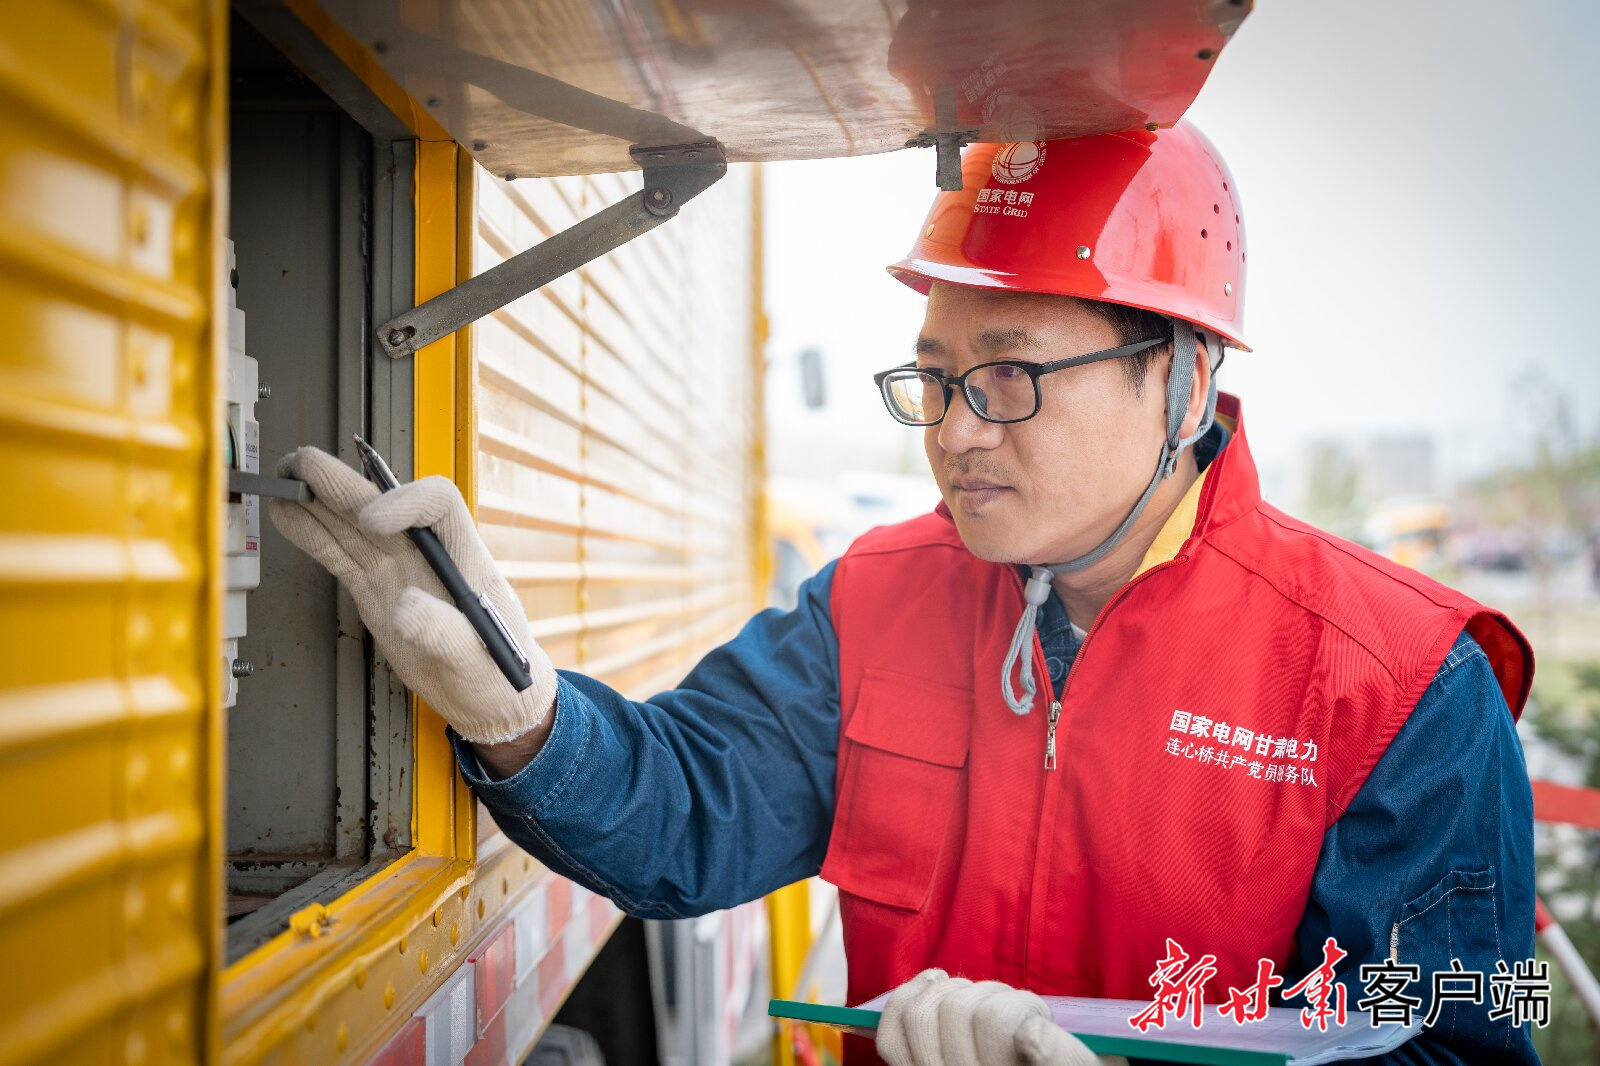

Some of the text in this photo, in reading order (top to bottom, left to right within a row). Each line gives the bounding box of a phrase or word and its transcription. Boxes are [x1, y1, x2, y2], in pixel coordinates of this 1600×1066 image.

[977, 188, 1034, 207] 国家电网
[973, 204, 1028, 218] STATE GRID
